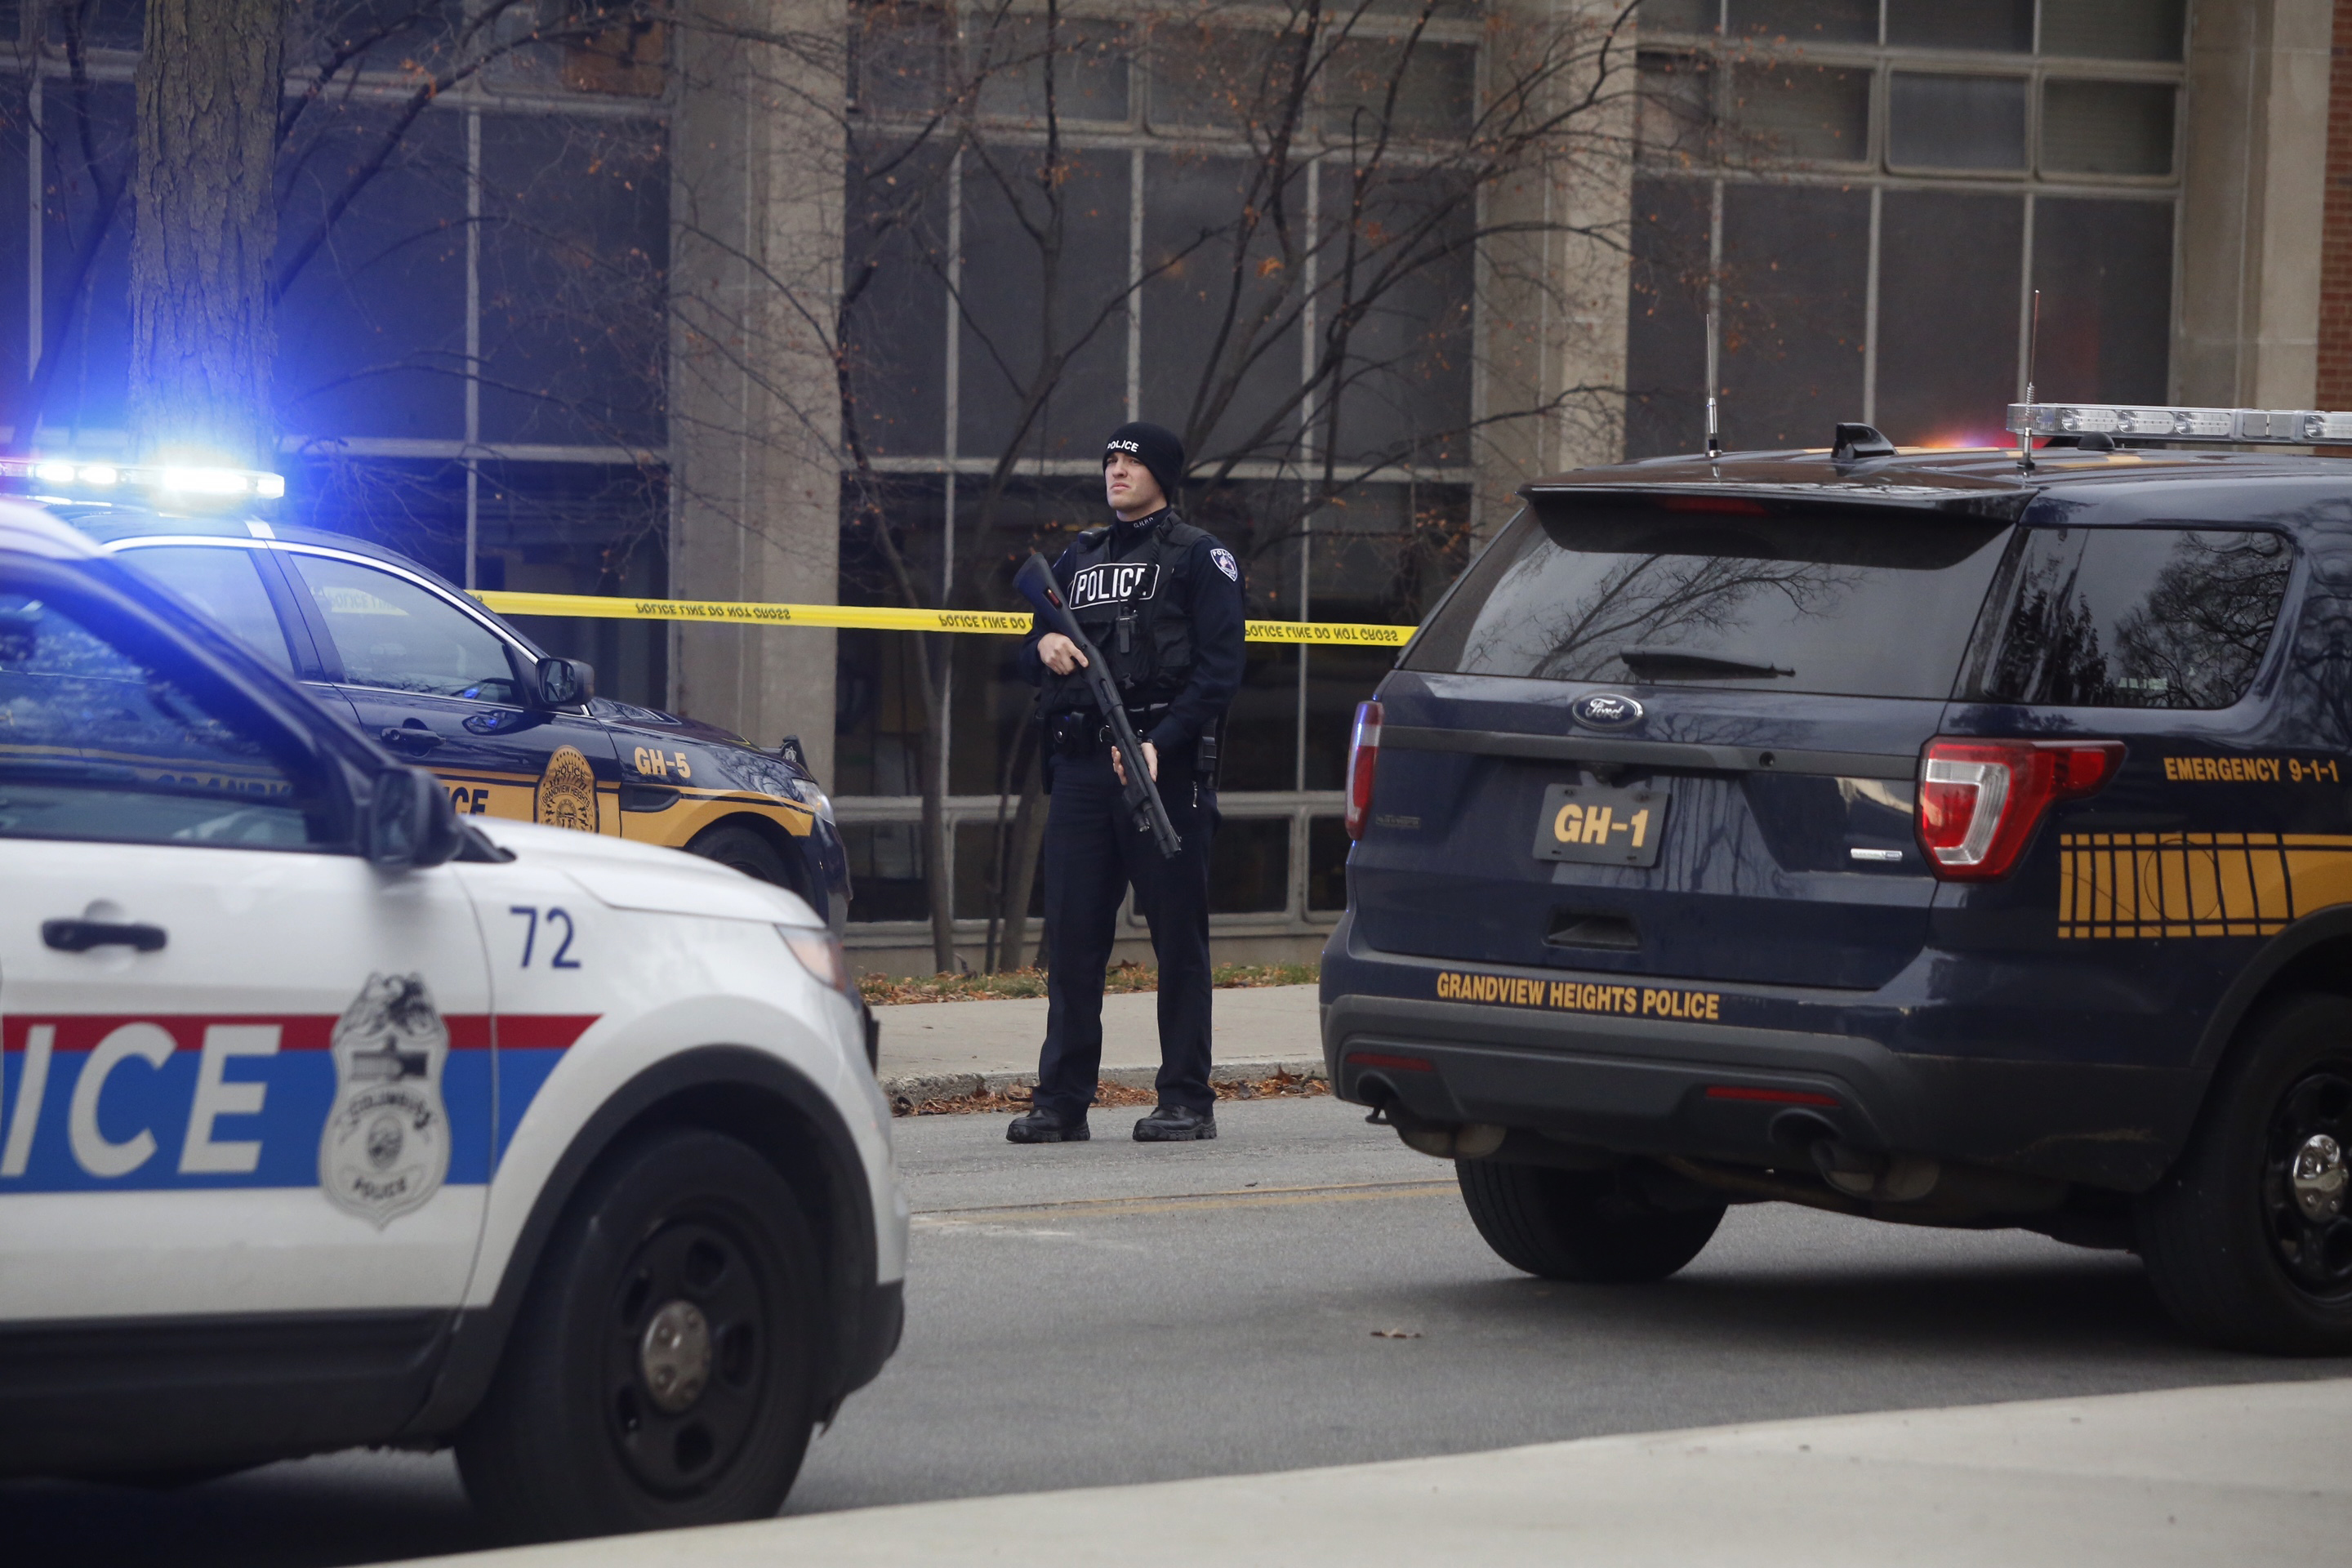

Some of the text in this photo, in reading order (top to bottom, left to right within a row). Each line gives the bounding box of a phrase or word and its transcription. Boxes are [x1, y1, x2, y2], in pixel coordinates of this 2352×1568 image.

[1107, 439, 1139, 452] POLICE
[1588, 698, 1625, 720] Ford
[555, 764, 586, 781] POLICE
[635, 746, 691, 778] GH-5
[2163, 757, 2340, 782] EMERGENCY 9-1-1
[444, 786, 488, 816] CE
[541, 784, 590, 808] GRANDVIEW HEIGHTS
[1554, 804, 1649, 848] GH-1
[509, 905, 581, 969] 72
[1437, 972, 1720, 1021] GRANDVIEW HEIGHTS POLICE
